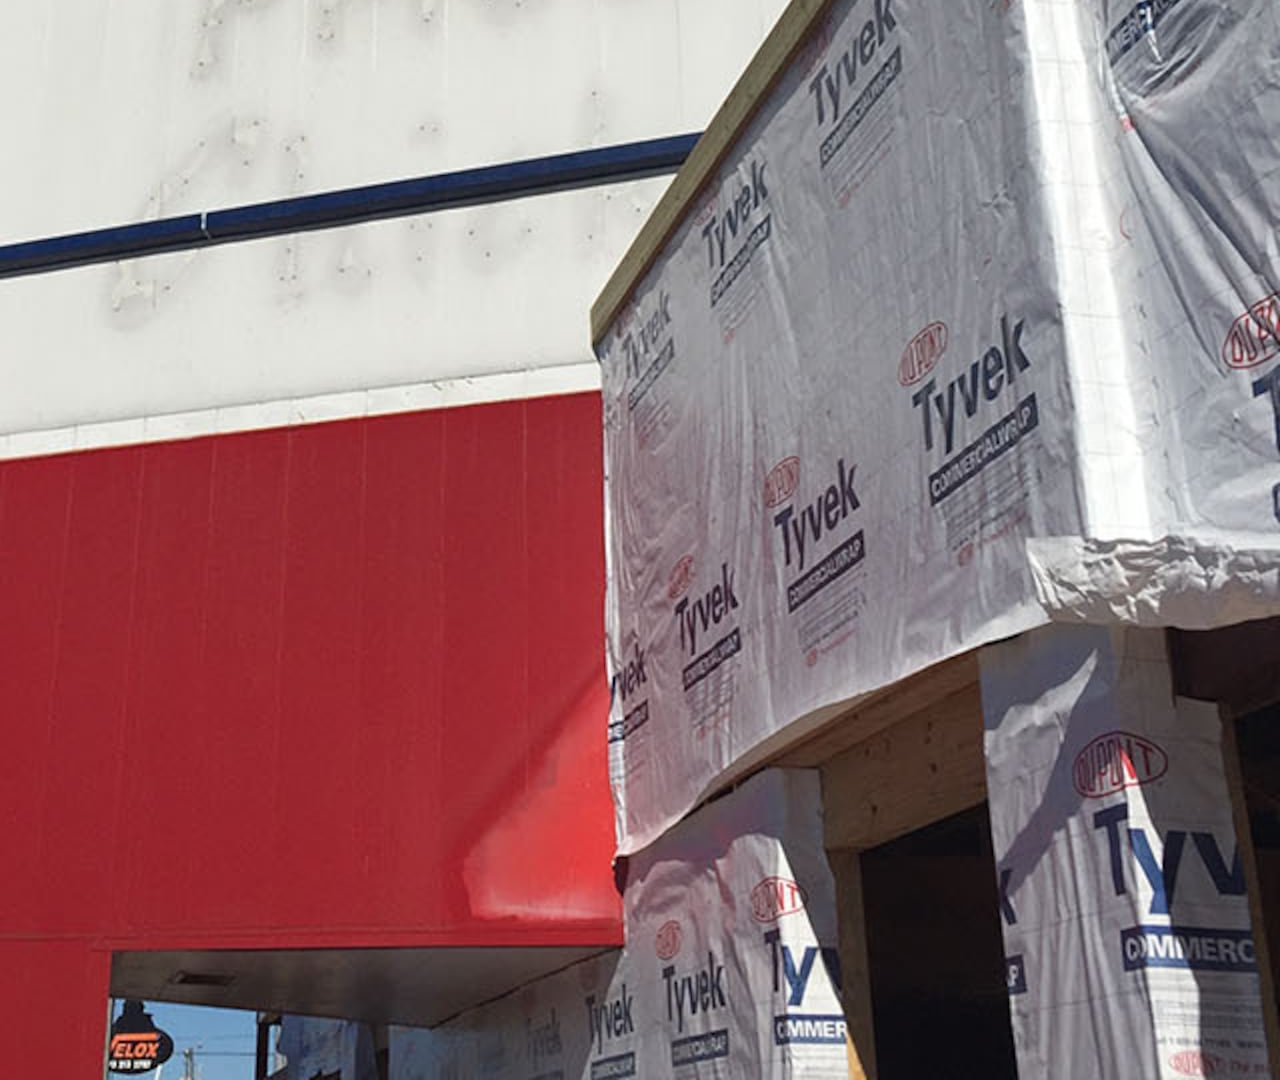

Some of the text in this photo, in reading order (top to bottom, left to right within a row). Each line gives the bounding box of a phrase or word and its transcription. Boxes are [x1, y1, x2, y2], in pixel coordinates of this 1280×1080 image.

[702, 159, 769, 268] Tyvek
[912, 312, 1031, 455] Tyvek
[774, 458, 861, 571] Tyvek
[675, 562, 739, 656] Tyvek
[1076, 736, 1154, 793] DUPONT
[586, 983, 634, 1055] Tyvek
[662, 951, 727, 1034] Tyvek
